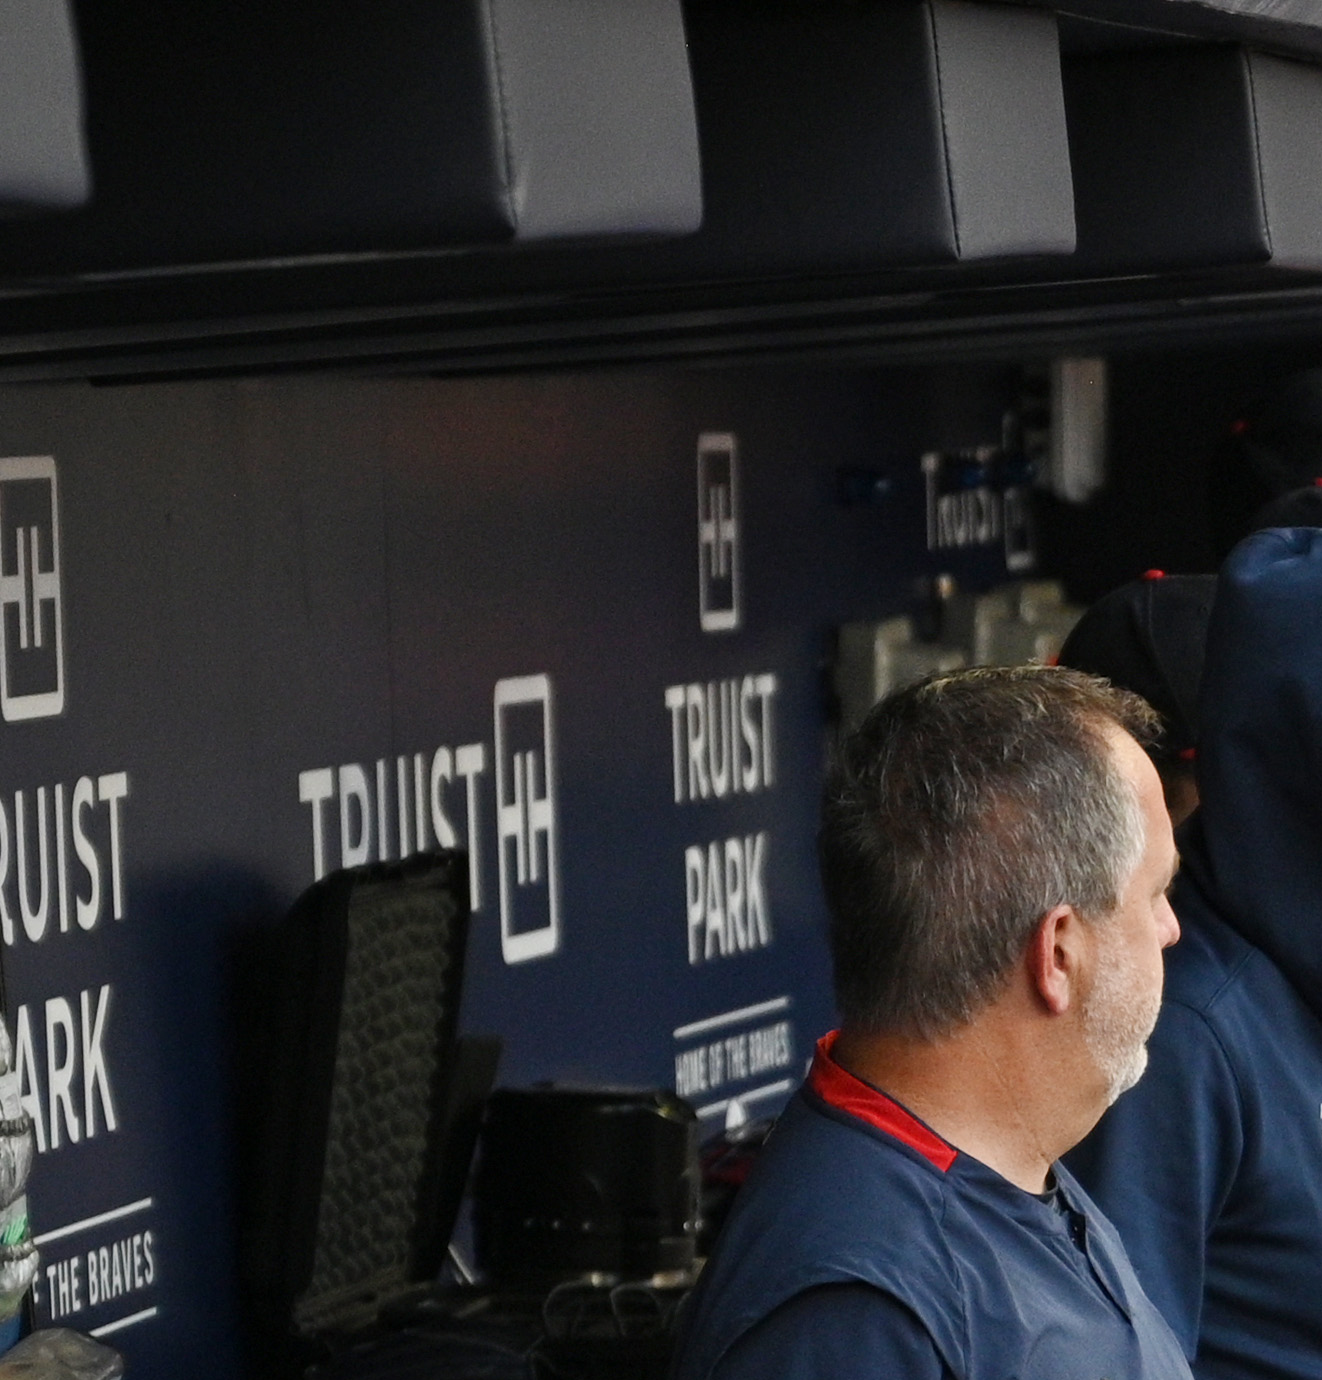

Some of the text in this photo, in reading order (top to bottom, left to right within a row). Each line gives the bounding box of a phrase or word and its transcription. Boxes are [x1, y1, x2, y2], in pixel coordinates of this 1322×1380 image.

[666, 673, 776, 803] TRUIST
[685, 831, 769, 965] PARK
[16, 984, 117, 1154] ARK
[46, 1263, 82, 1321] THE
[88, 1230, 155, 1305] BRAVES
